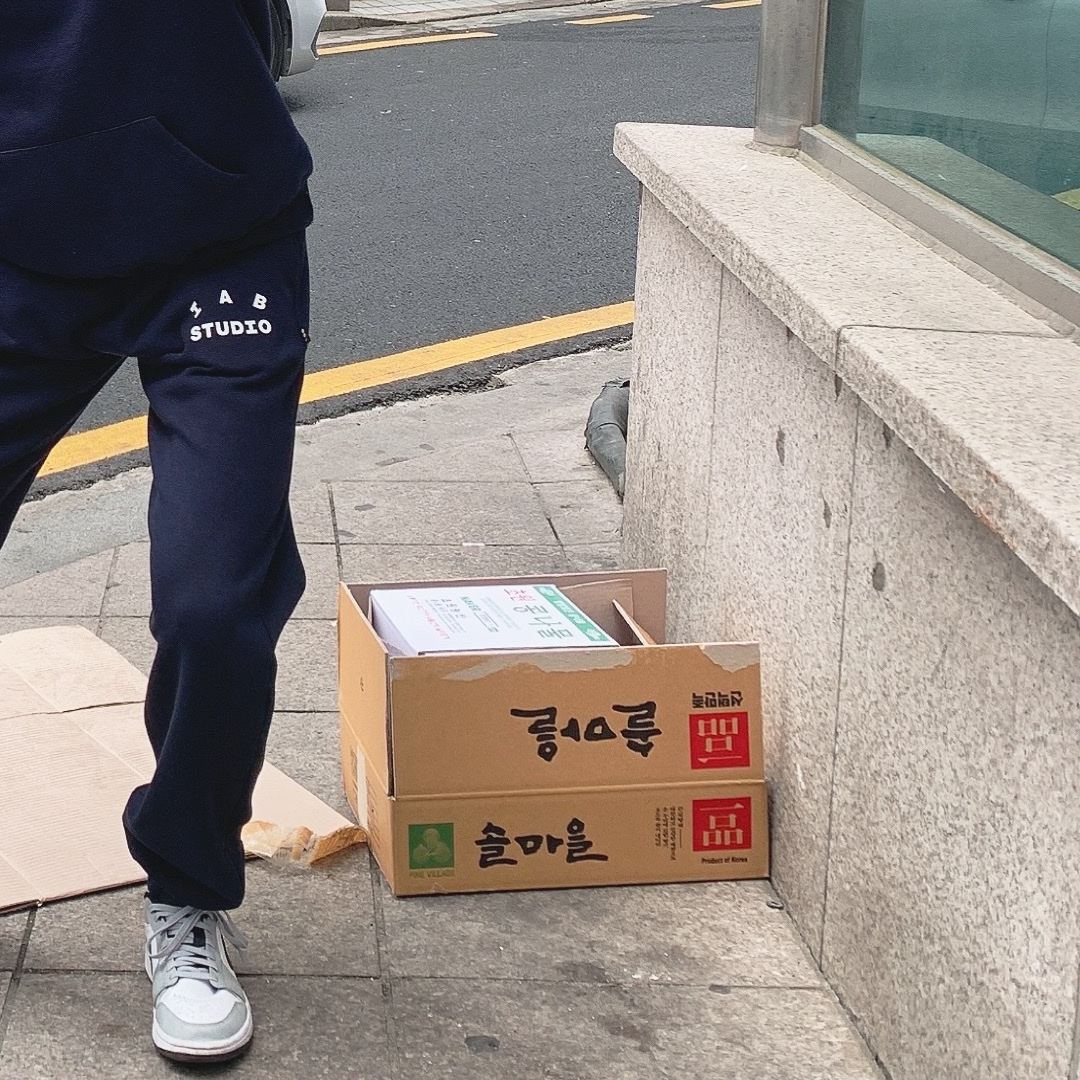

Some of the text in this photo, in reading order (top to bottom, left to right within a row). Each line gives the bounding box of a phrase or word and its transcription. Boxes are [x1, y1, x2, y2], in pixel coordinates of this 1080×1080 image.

[190, 319, 272, 342] STUDIO
[513, 604, 575, 639] 콩나물
[510, 700, 663, 763] 솔마을
[474, 817, 609, 869] 솔마을
